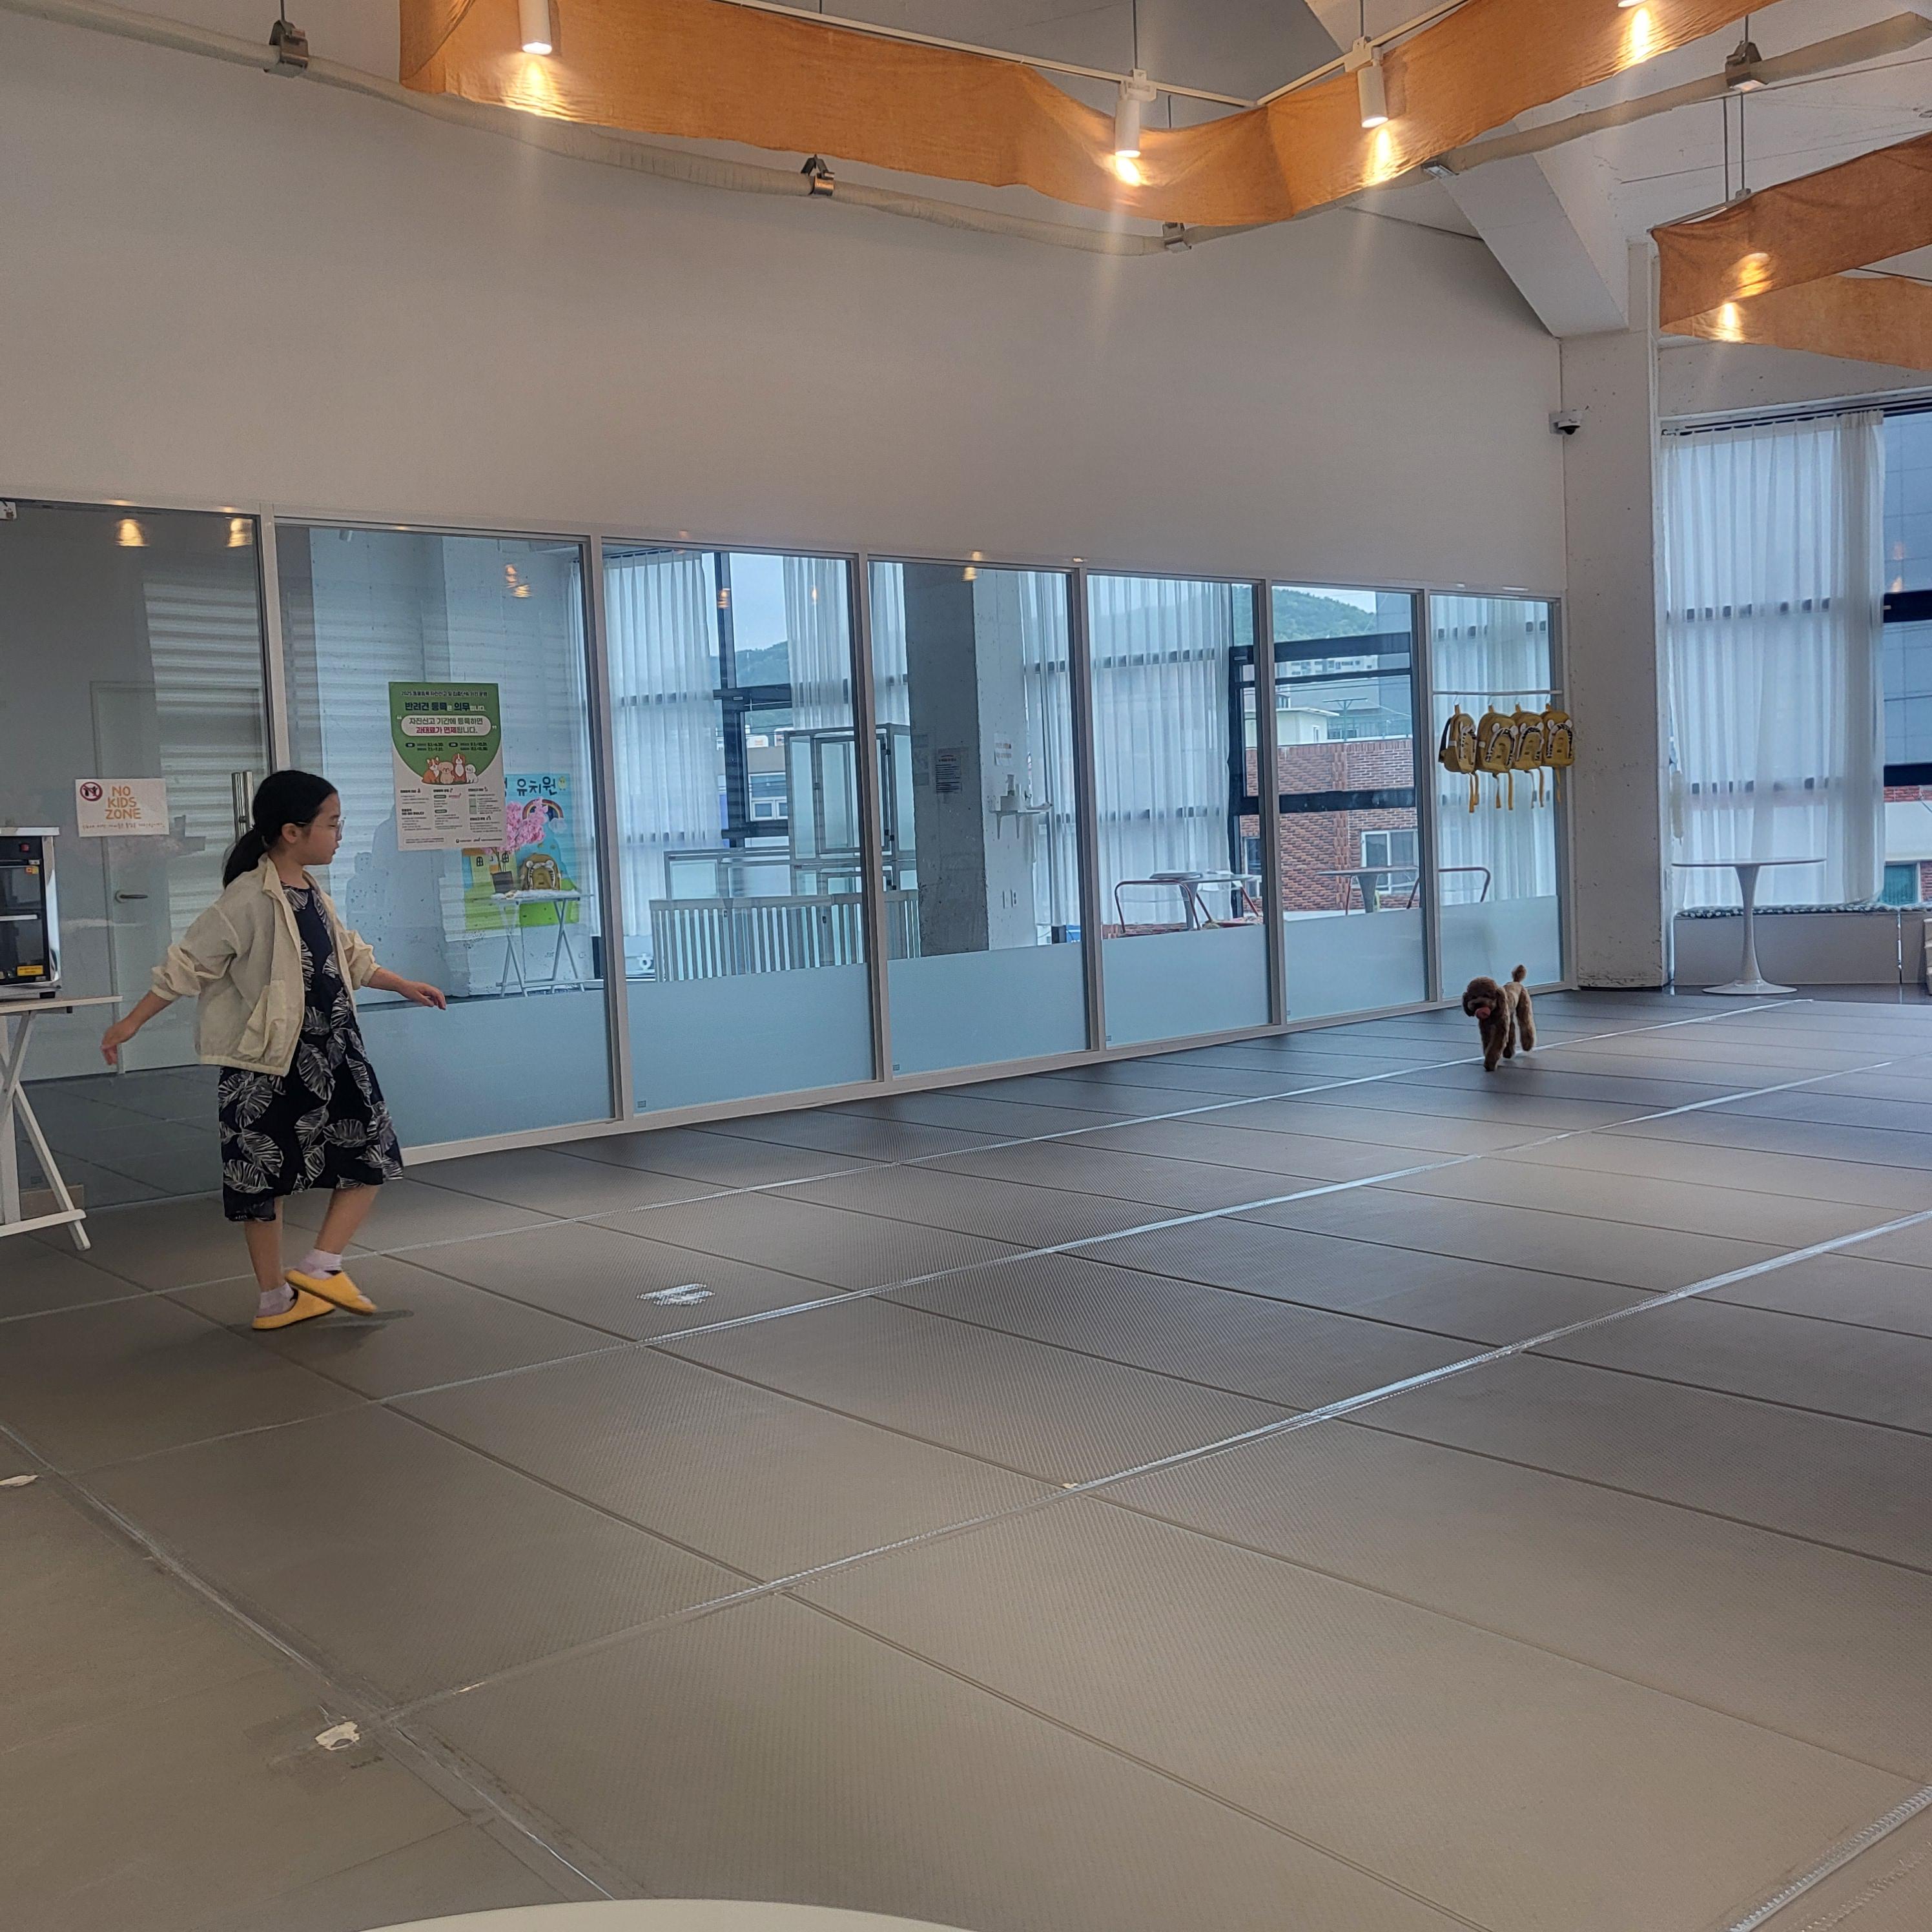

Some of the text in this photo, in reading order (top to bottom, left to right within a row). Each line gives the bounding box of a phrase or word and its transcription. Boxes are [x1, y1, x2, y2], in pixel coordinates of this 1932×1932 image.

[431, 702, 452, 712] 등록은
[111, 786, 130, 797] NO
[516, 776, 558, 797] 유치원
[107, 797, 137, 808] KIDS
[105, 808, 142, 820] ZONE
